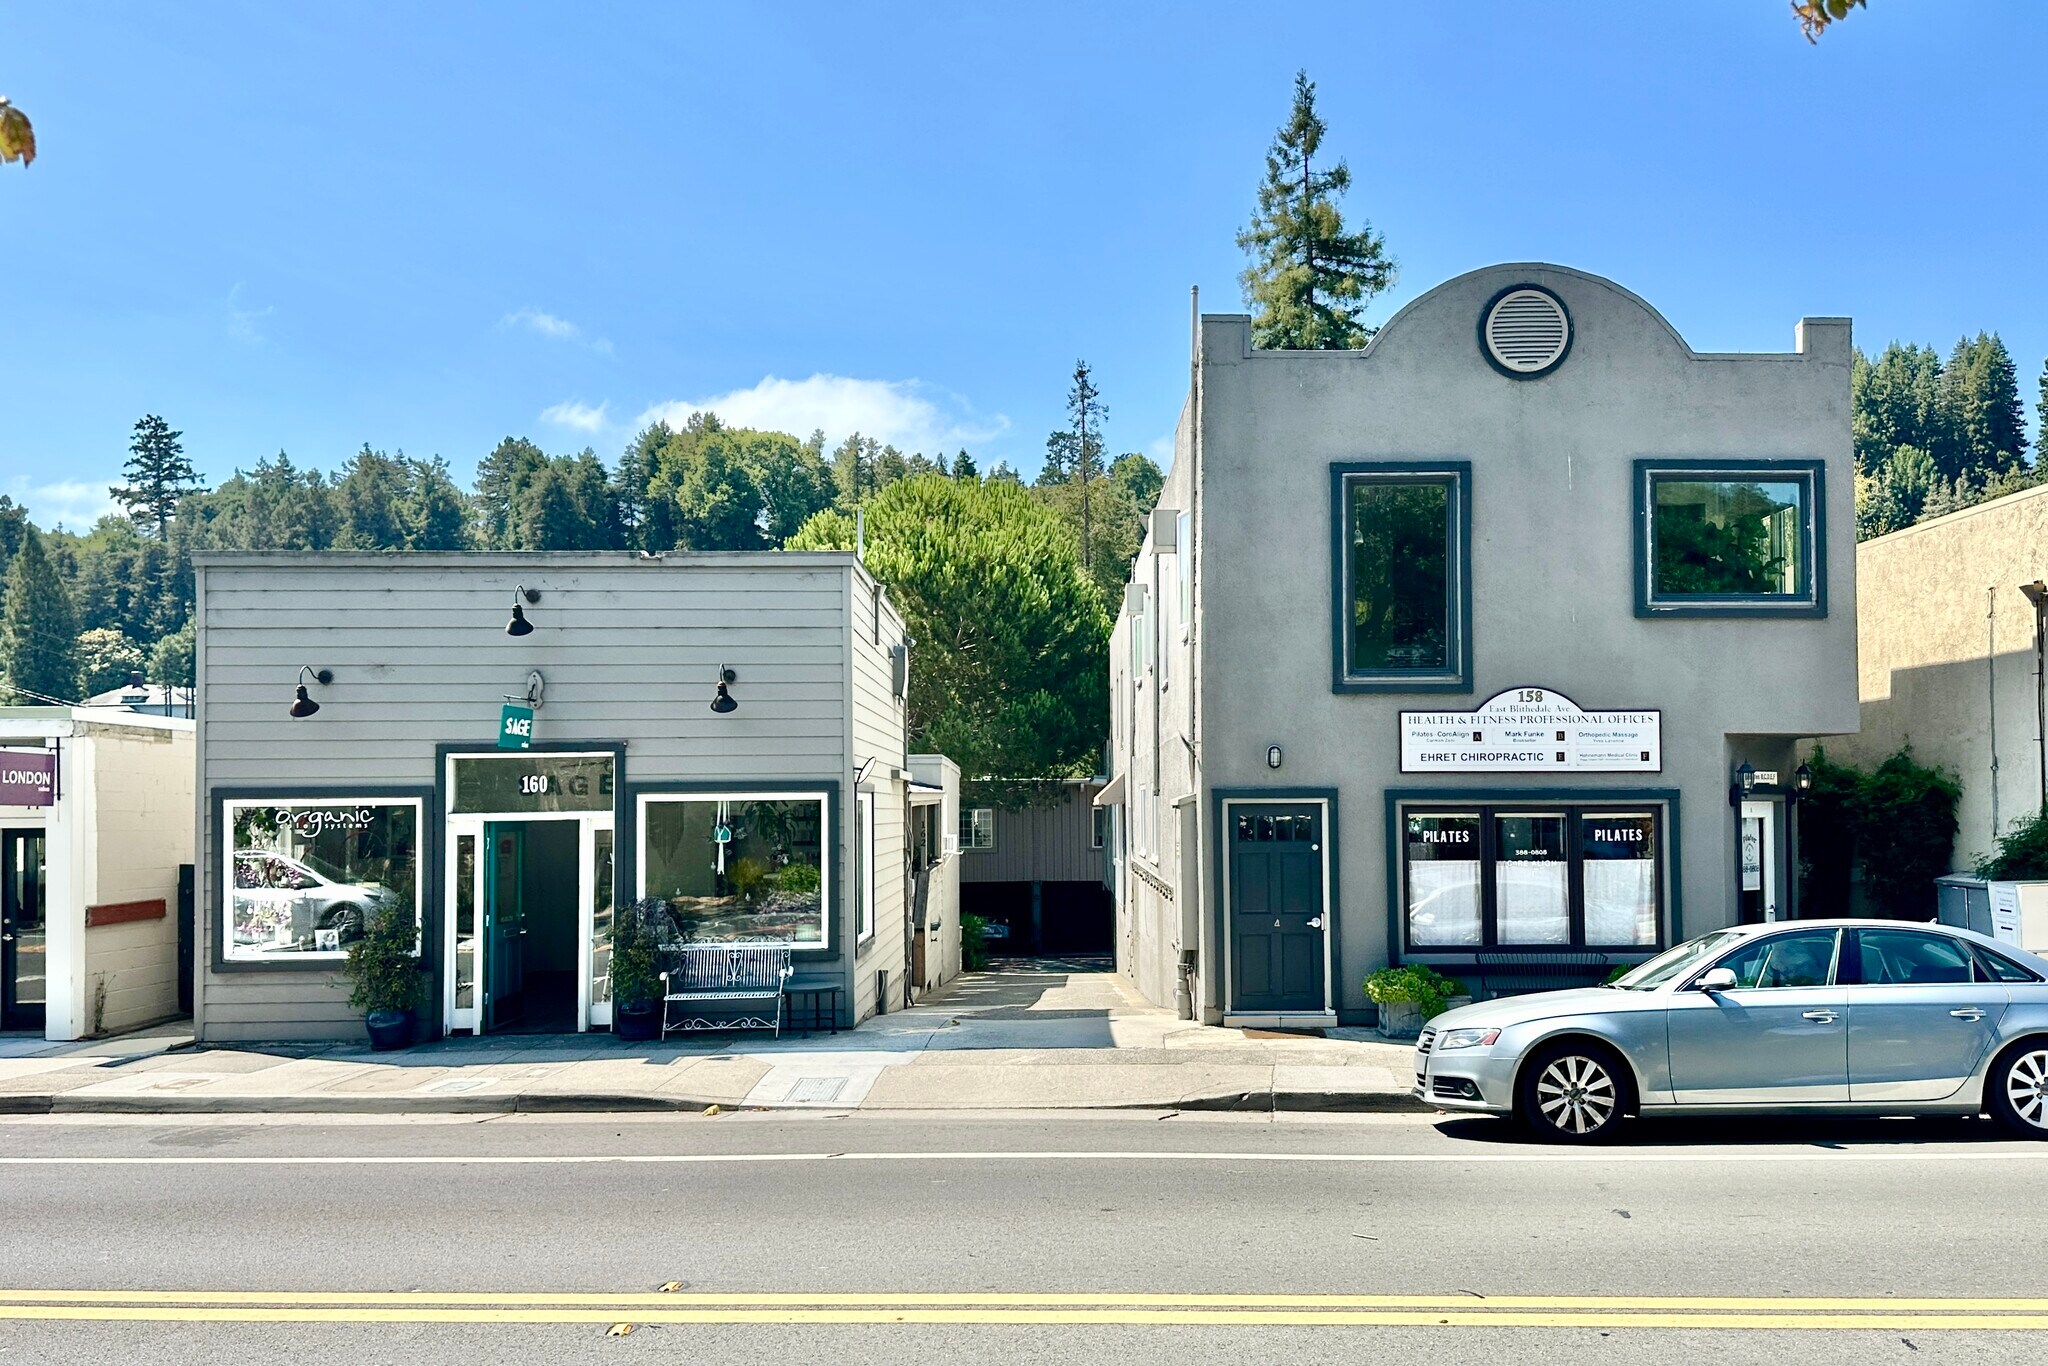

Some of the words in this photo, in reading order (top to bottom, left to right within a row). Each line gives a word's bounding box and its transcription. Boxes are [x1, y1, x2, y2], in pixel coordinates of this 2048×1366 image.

[1518, 690, 1543, 702] 158
[1489, 704, 1506, 713] East
[1509, 704, 1551, 713] Blithedale
[504, 717, 531, 736] SAGE
[1408, 716, 1454, 725] HEALTH
[1457, 716, 1467, 725] &
[1470, 716, 1517, 725] FITNESS
[1520, 715, 1605, 724] PROFESSIONAL
[1608, 715, 1654, 724] OFFICES
[1420, 753, 1457, 762] EHRET
[1460, 752, 1544, 761] CHIROPRACTIC
[2, 770, 51, 785] LONDON
[522, 775, 548, 793] 160
[275, 805, 375, 838] organic
[1423, 830, 1470, 843] PILATES
[1594, 828, 1643, 841] PILATES
